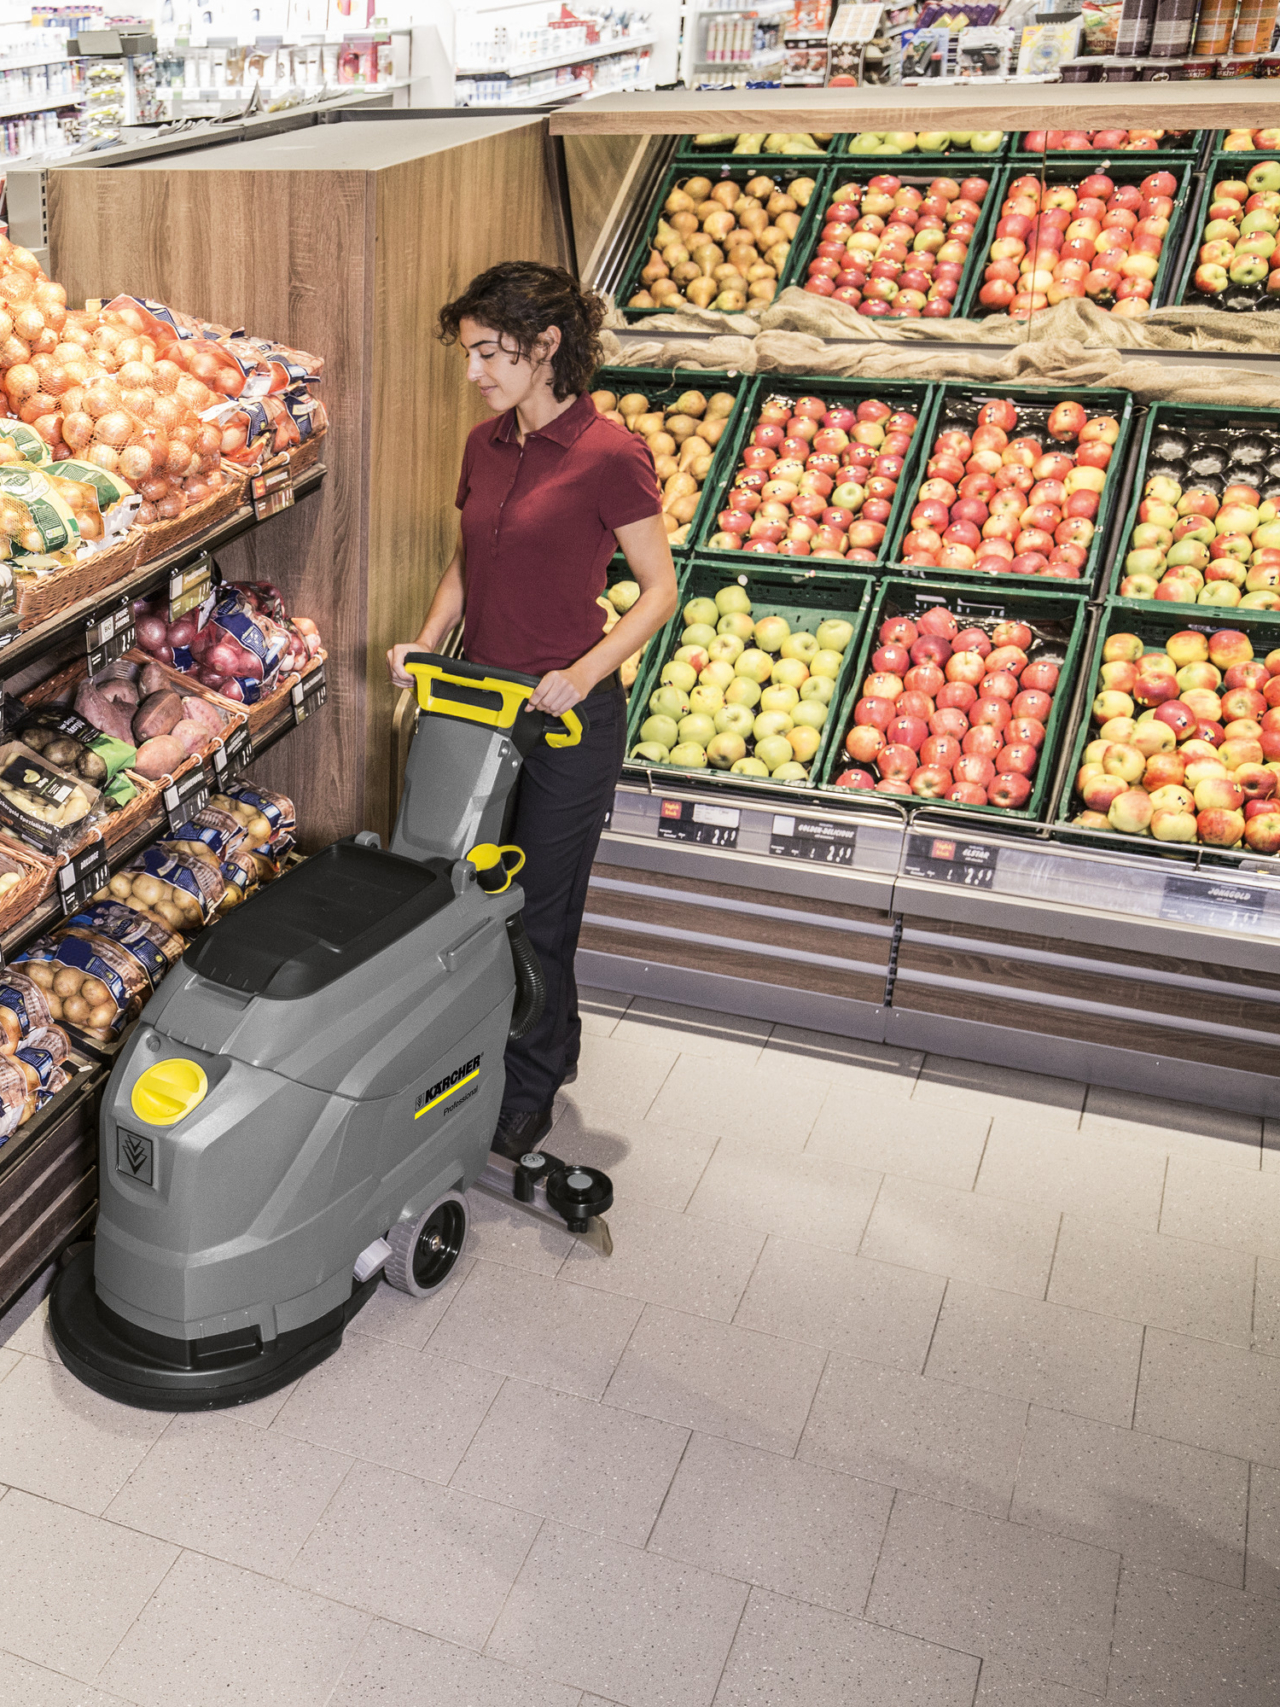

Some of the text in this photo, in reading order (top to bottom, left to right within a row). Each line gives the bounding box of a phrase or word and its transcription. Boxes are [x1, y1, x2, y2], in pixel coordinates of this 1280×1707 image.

[962, 847, 991, 860] ELSTAR
[1207, 887, 1252, 902] JONAGOLD
[443, 1085, 479, 1117] Professional
